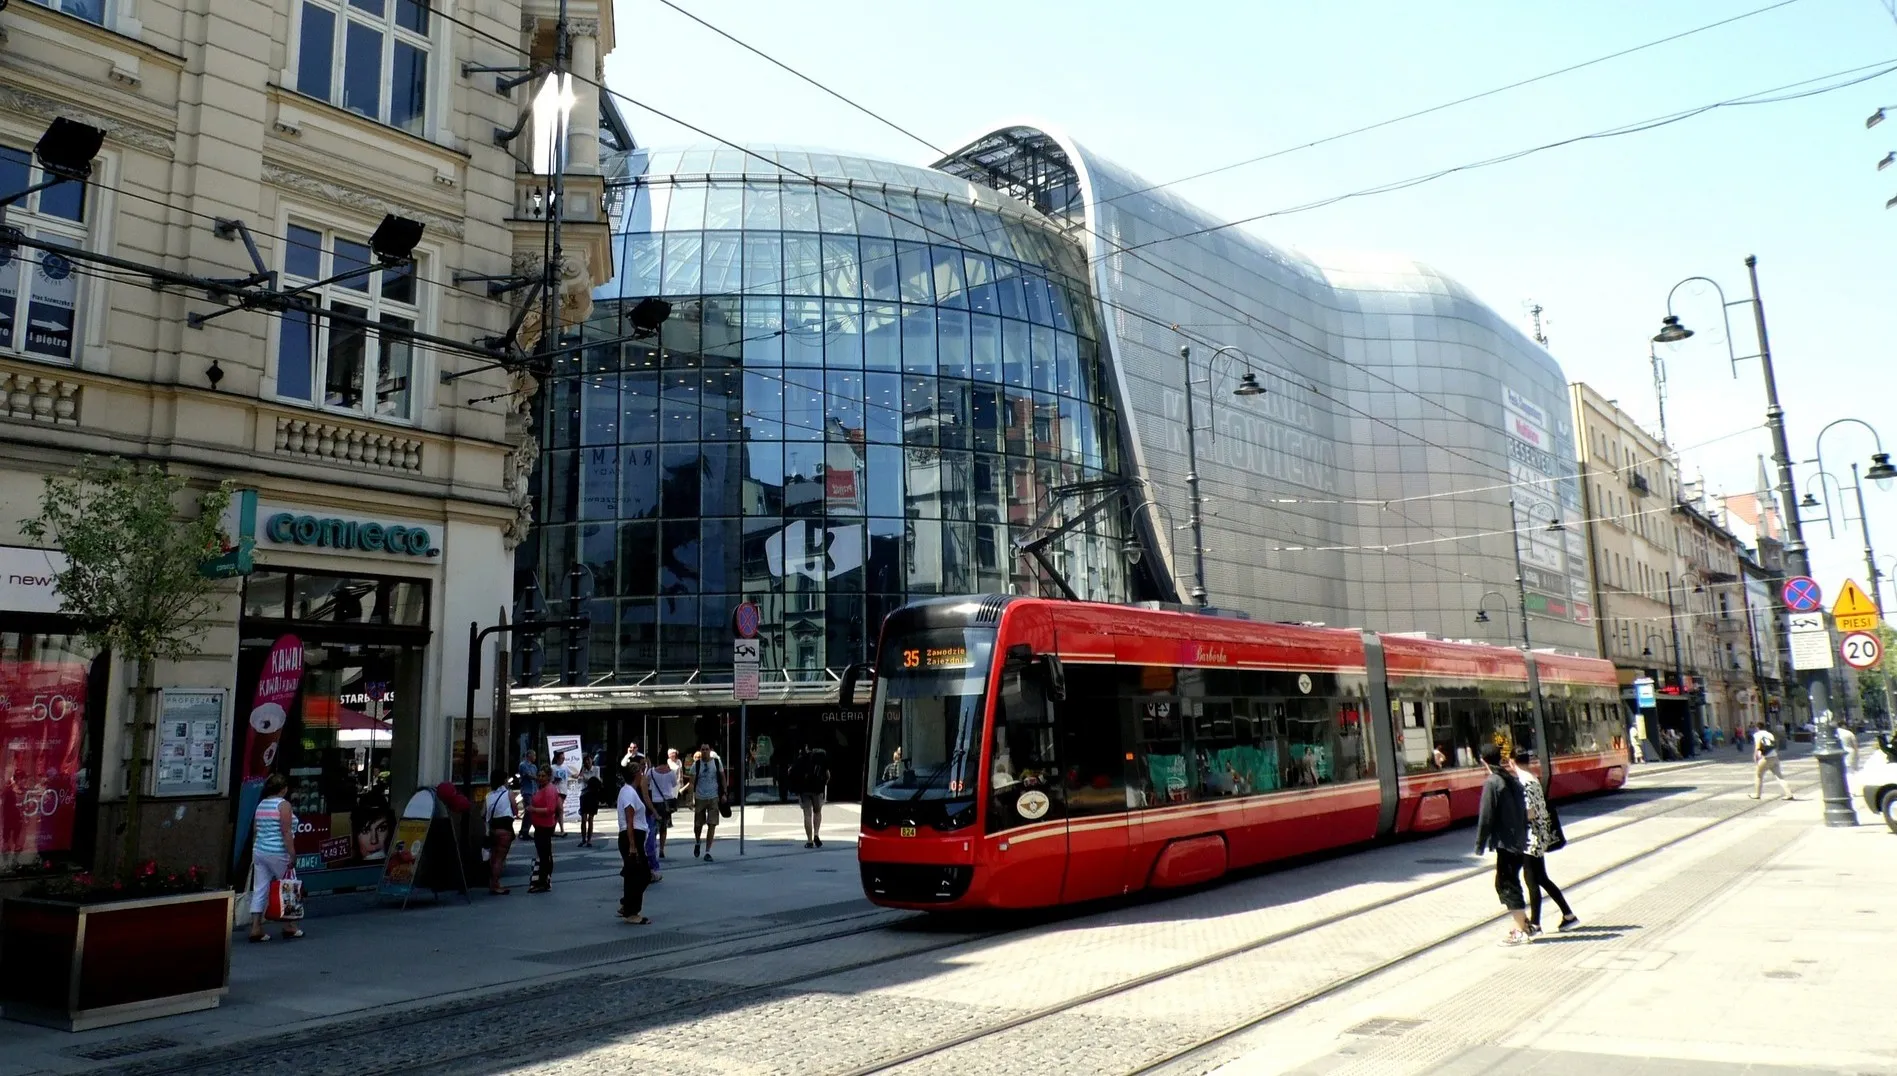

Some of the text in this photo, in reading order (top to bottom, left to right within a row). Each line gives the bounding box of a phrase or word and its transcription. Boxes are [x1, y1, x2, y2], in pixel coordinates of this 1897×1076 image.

[36, 335, 68, 348] piętro
[9, 574, 52, 587] new
[927, 647, 965, 657] Zawodzie
[1847, 640, 1876, 660] 20
[272, 647, 302, 674] KAWA!
[903, 649, 920, 668] 35
[259, 676, 282, 697] KAWA!
[340, 692, 394, 704] STARBKS
[24, 694, 79, 721] -50%
[821, 711, 864, 722] GALERIA
